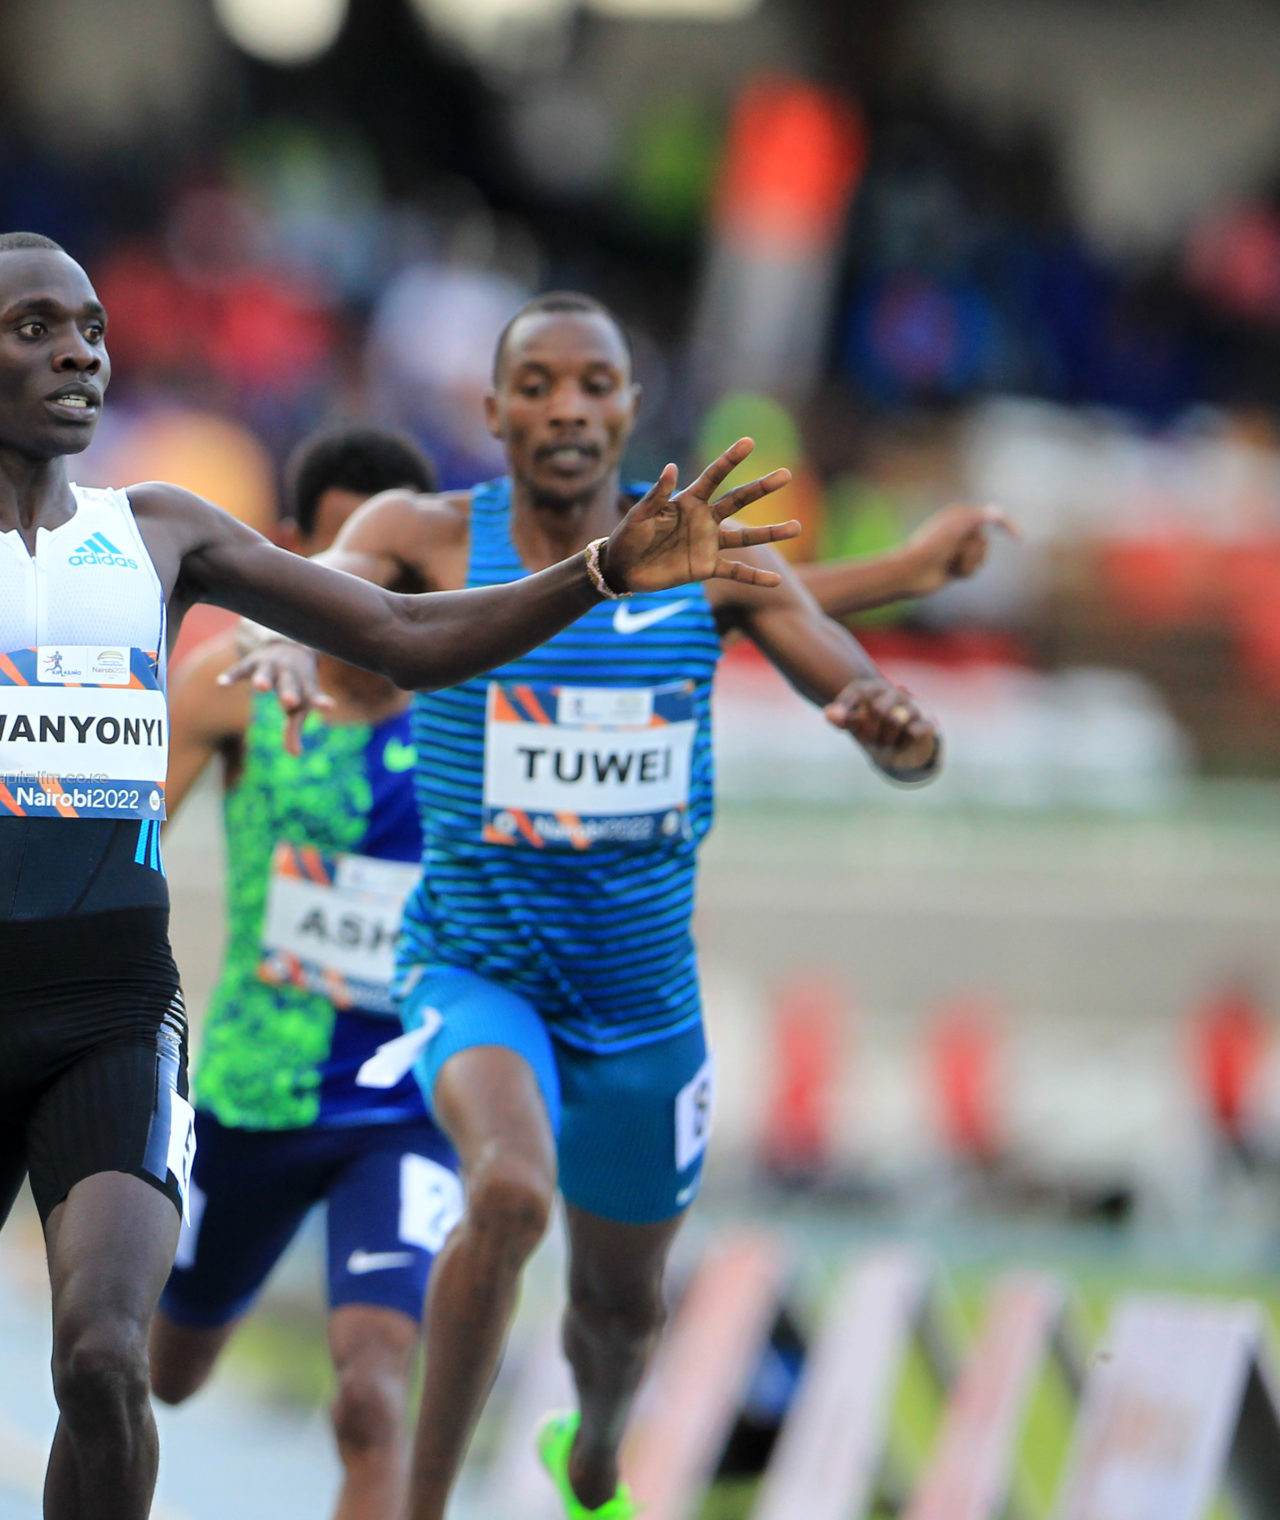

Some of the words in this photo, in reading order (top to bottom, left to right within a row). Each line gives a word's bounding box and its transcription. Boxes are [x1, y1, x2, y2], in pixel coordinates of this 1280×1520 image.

[68, 552, 138, 569] adidas
[518, 746, 672, 784] TUWEI
[16, 787, 140, 810] Nairobi2022
